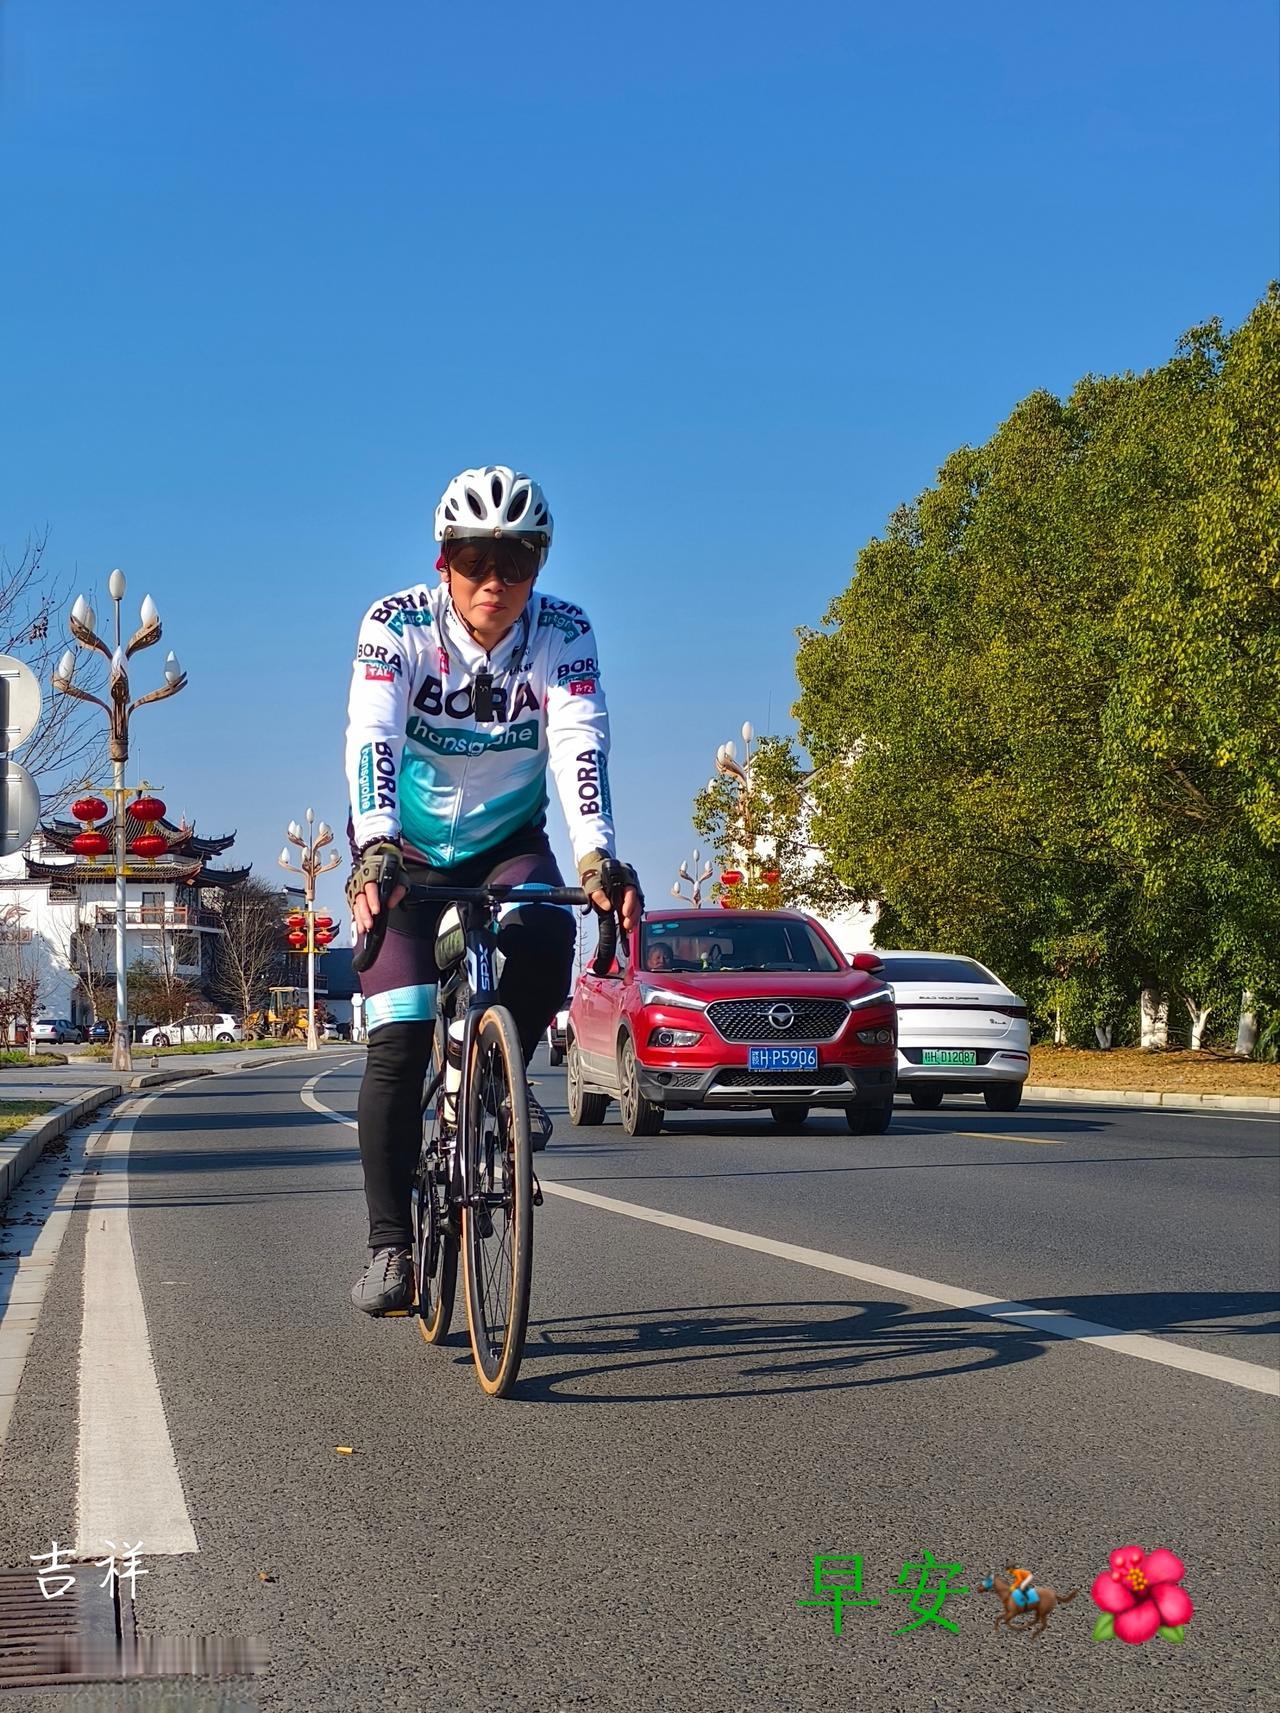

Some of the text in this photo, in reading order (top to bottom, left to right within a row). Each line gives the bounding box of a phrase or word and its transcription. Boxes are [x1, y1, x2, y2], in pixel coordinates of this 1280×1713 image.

[557, 657, 597, 679] BOR
[412, 716, 534, 757] hansghe
[375, 742, 396, 809] BORA
[576, 749, 600, 816] BORA
